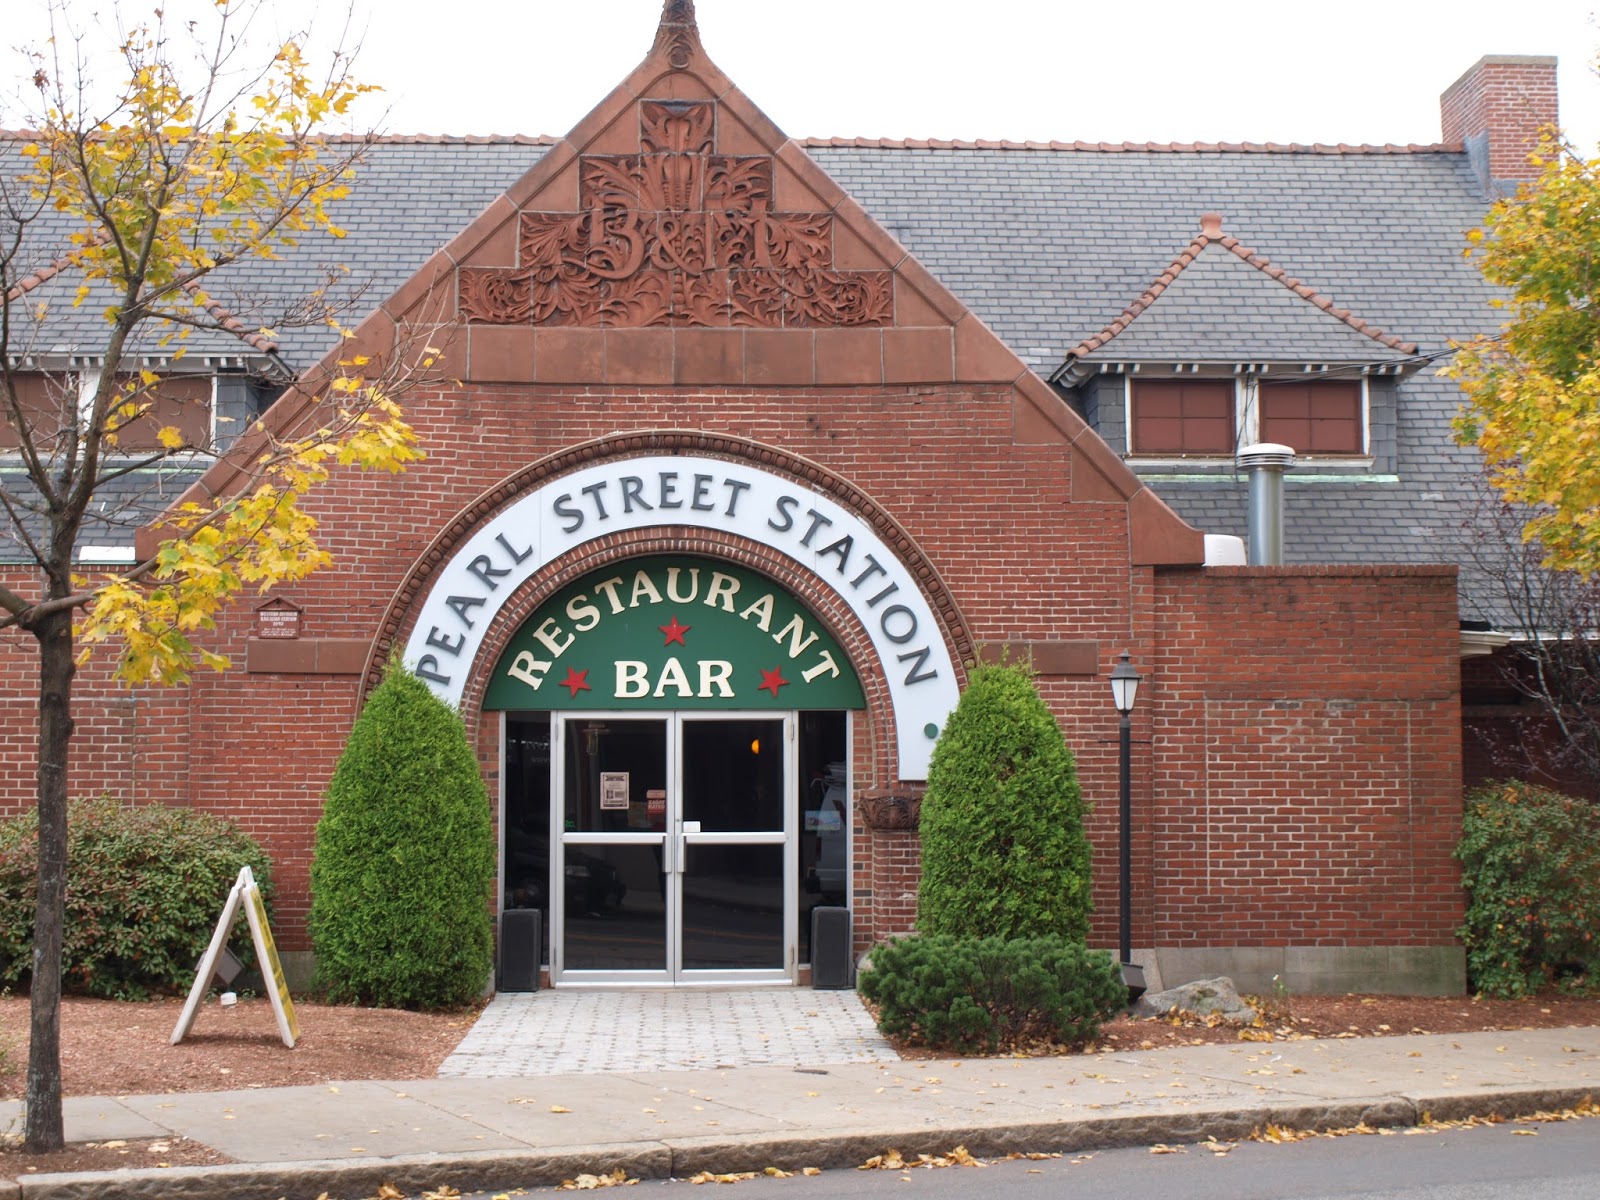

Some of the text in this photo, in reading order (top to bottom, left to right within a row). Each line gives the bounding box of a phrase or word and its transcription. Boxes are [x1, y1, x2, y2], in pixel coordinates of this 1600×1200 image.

[416, 471, 939, 686] PEARL STREET STATION
[507, 567, 840, 691] RESTAURANT
[613, 657, 734, 698] BAR
